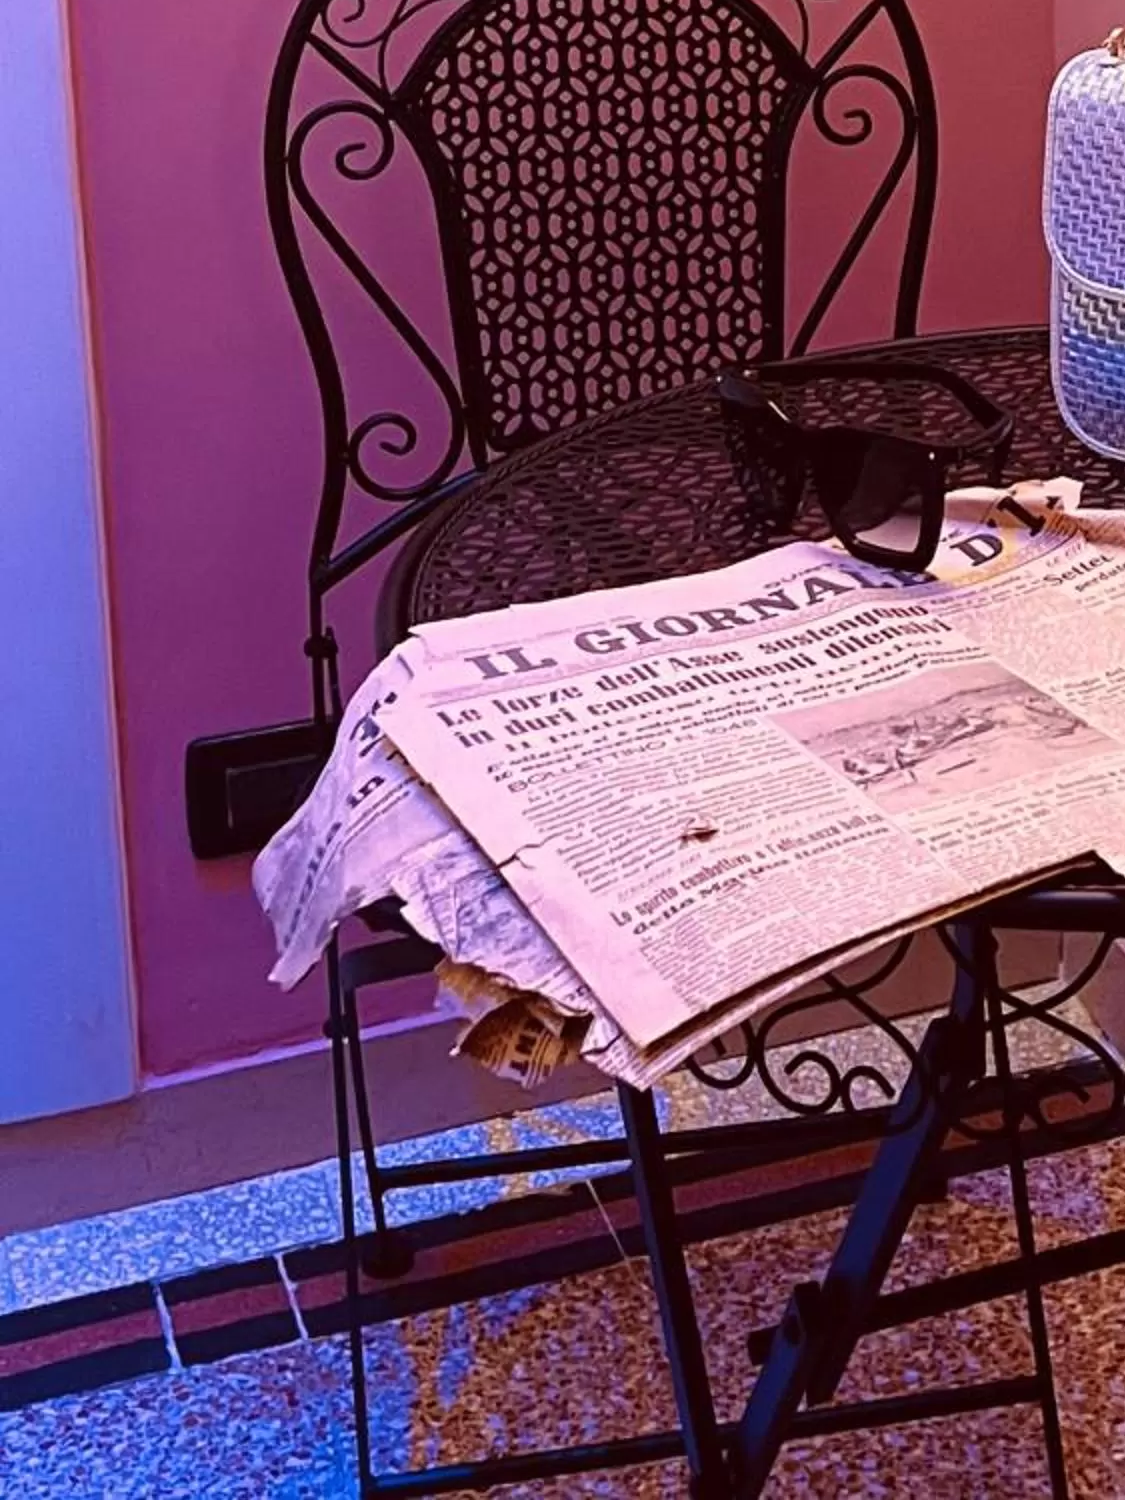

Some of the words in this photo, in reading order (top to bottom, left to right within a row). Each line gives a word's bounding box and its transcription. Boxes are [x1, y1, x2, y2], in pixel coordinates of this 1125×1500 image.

[436, 707, 483, 728] Le
[595, 650, 744, 692] dell'Asse
[757, 604, 929, 655] sostengono
[453, 729, 496, 749] in
[504, 706, 578, 737] duri
[586, 652, 818, 717] combattimenti
[824, 617, 953, 660] difensivi
[463, 646, 559, 681] IL
[506, 740, 667, 794] BOLLETTINO
